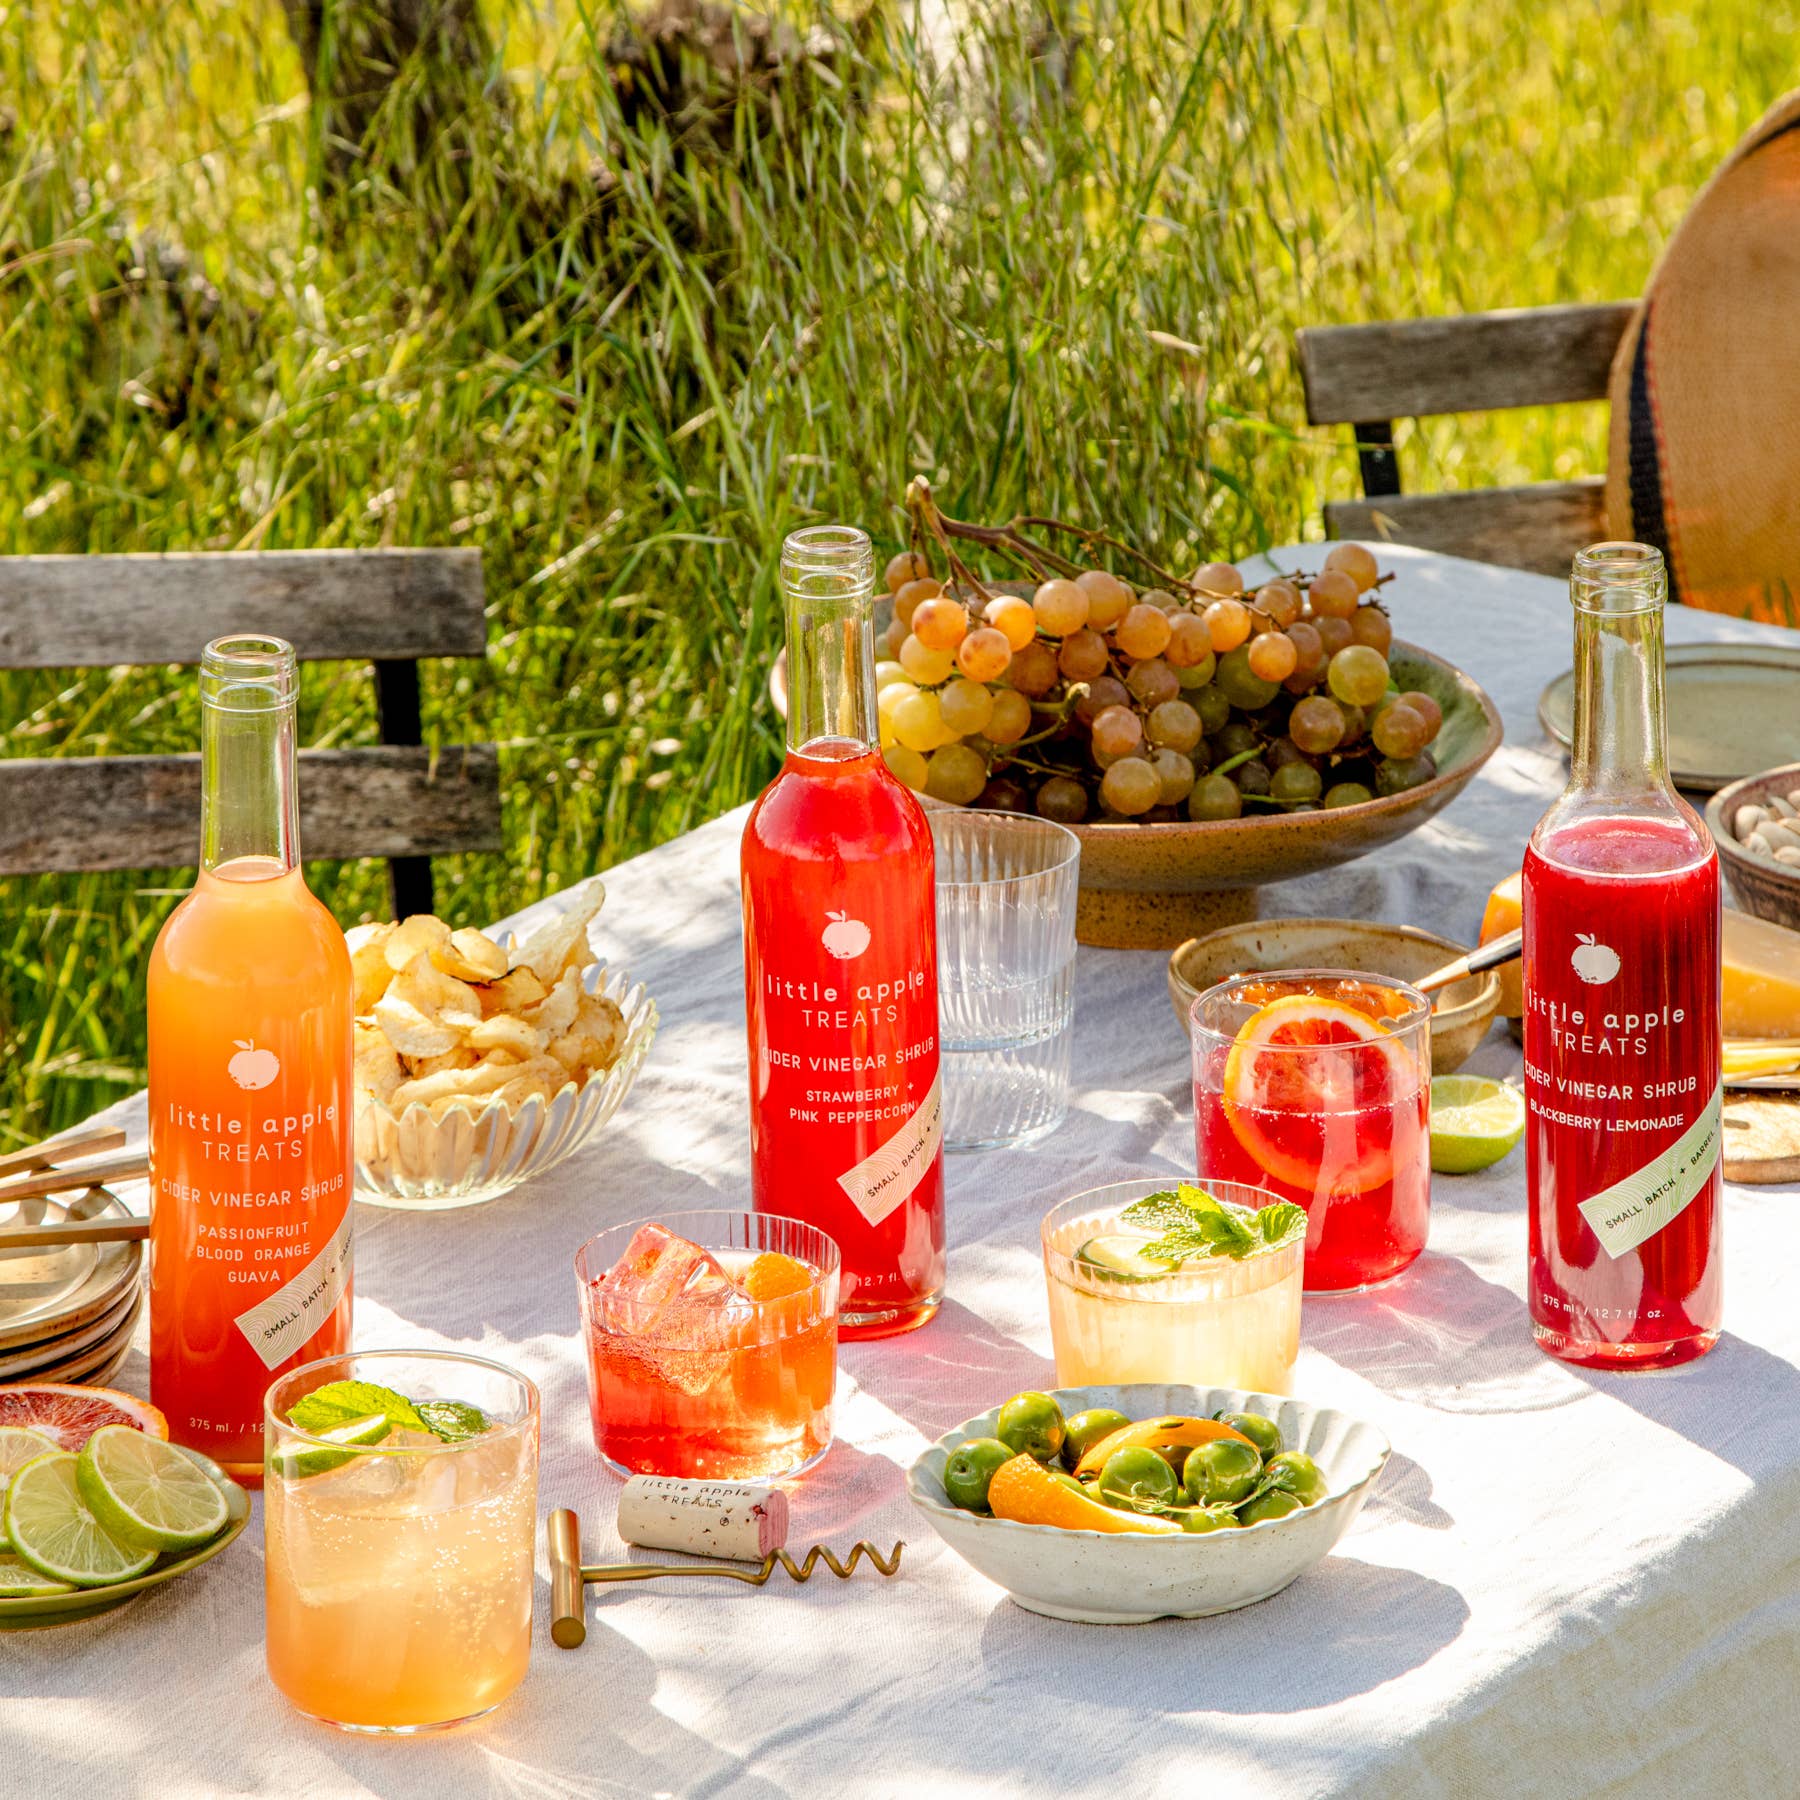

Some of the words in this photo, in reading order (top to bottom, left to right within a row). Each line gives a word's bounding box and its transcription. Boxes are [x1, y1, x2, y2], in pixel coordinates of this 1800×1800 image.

[767, 974, 838, 1002] little
[857, 971, 925, 1004] apple
[802, 1005, 898, 1029] TREATS
[1528, 987, 1585, 1025] little
[1604, 1005, 1686, 1035] apple
[762, 1047, 801, 1070] CIDER
[809, 1055, 887, 1072] VINEGAR
[896, 1036, 934, 1065] SHRUB
[1552, 1028, 1648, 1056] TREATS
[806, 1084, 899, 1103] STRAWBERRY
[907, 1082, 914, 1091] +
[1556, 1077, 1633, 1100] VINEGAR
[1643, 1076, 1697, 1099] SHRUB
[169, 1103, 242, 1134] little
[262, 1104, 335, 1137] apple
[790, 1107, 819, 1123] PINK
[828, 1101, 915, 1124] PEPPERCORN
[1530, 1097, 1602, 1130] BLACKBERRY
[1606, 1113, 1684, 1132] LEMONADE
[202, 1139, 303, 1163] TREATS
[866, 1169, 900, 1198] SMALL
[901, 1137, 925, 1168] BATCH
[1605, 1205, 1643, 1229] SMALL
[1644, 1177, 1677, 1206] BATCH
[1690, 1130, 1715, 1166] BARREL
[161, 1178, 201, 1204] CIDER
[209, 1190, 292, 1208] VINEGAR
[301, 1173, 344, 1202] SHRUB
[198, 1221, 309, 1241] PASSIONFRUIT
[196, 1245, 244, 1262] BLOOD
[254, 1242, 311, 1262] ORANGE
[227, 1269, 281, 1284] GUAVA
[858, 1274, 883, 1288] 12.7
[264, 1311, 300, 1339] SMALL
[301, 1280, 328, 1309] BATCH
[1543, 1293, 1560, 1309] 375
[1595, 1308, 1623, 1320] 127
[1647, 1308, 1665, 1319] oz.
[189, 1417, 211, 1431] 375
[216, 1423, 233, 1433] ml.
[641, 1478, 689, 1492] little
[700, 1486, 751, 1497] apple
